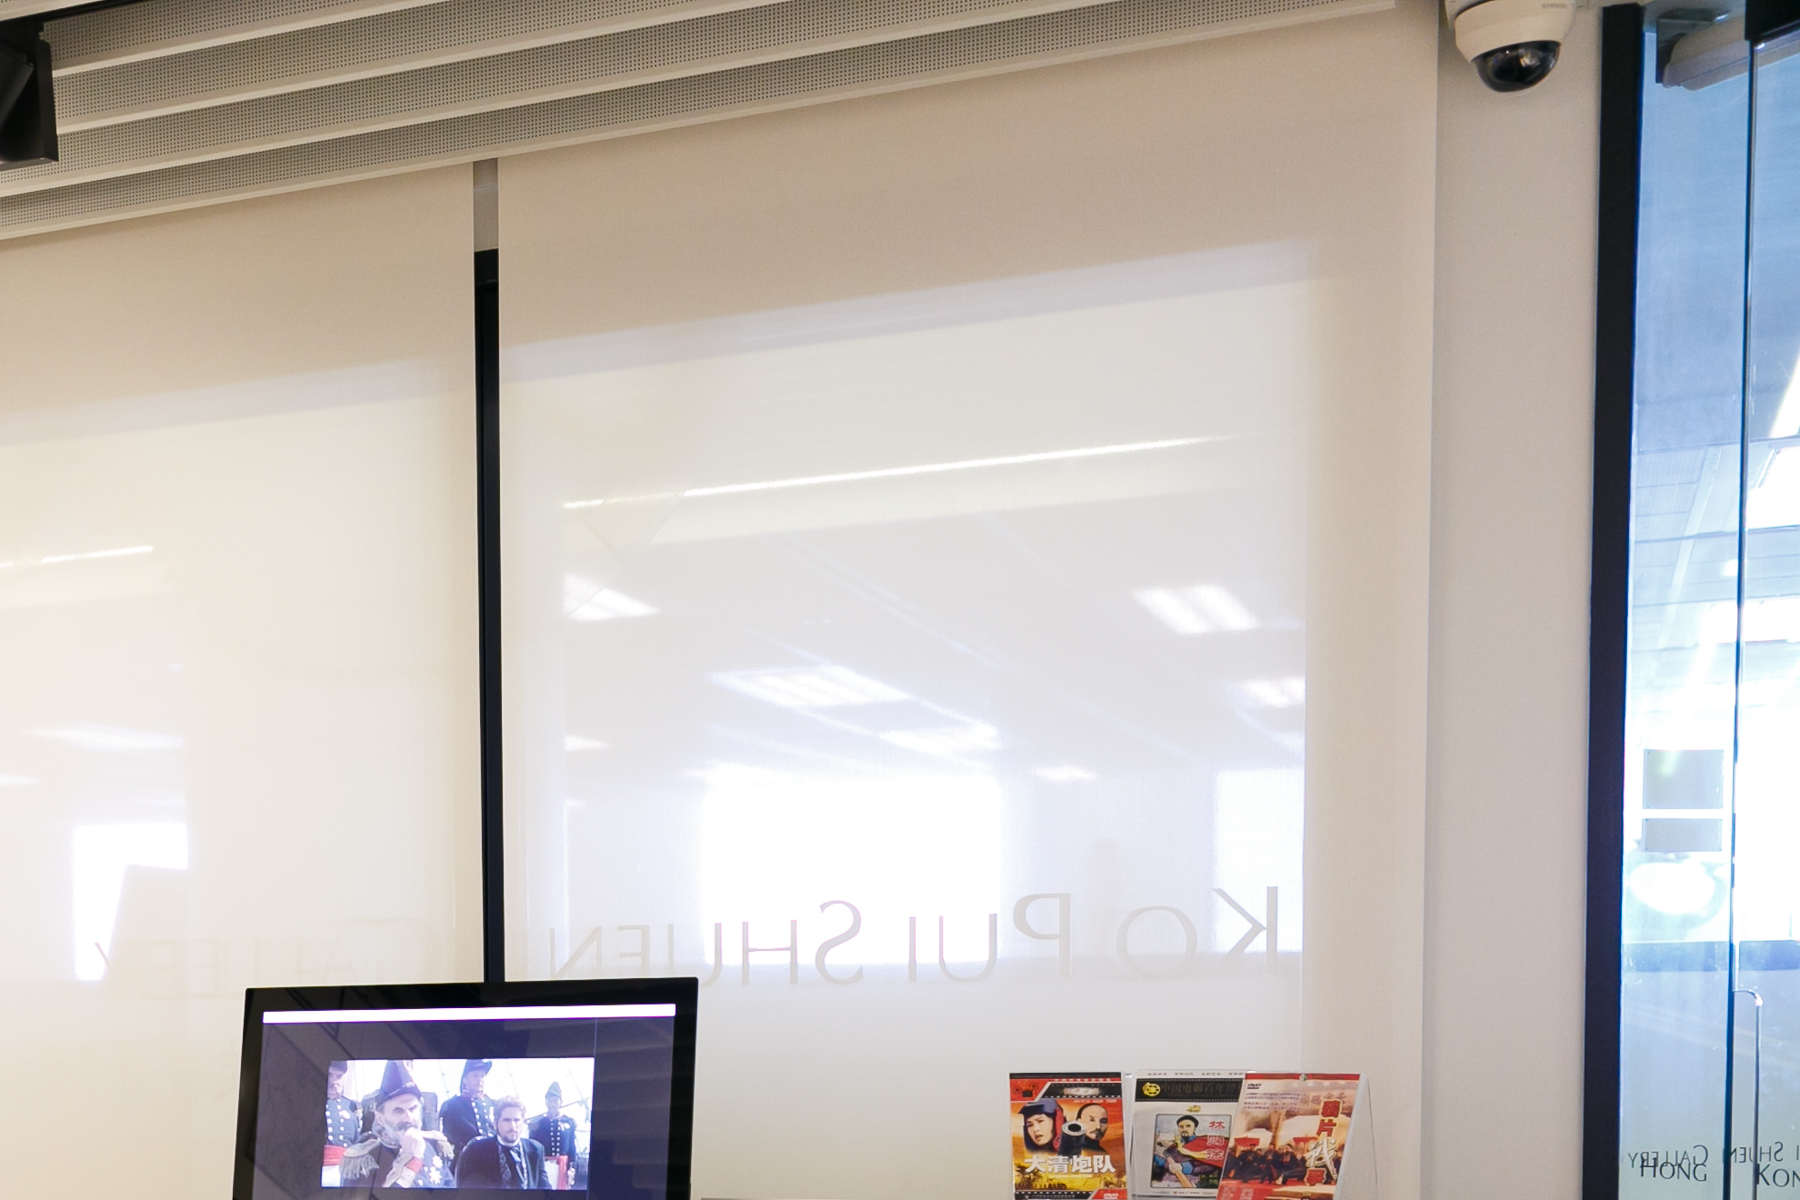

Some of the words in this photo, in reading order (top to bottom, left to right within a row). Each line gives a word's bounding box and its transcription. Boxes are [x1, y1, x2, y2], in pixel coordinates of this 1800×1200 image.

[1024, 1154, 1116, 1174] 大清炮队
[1640, 1156, 1708, 1182] HONG
